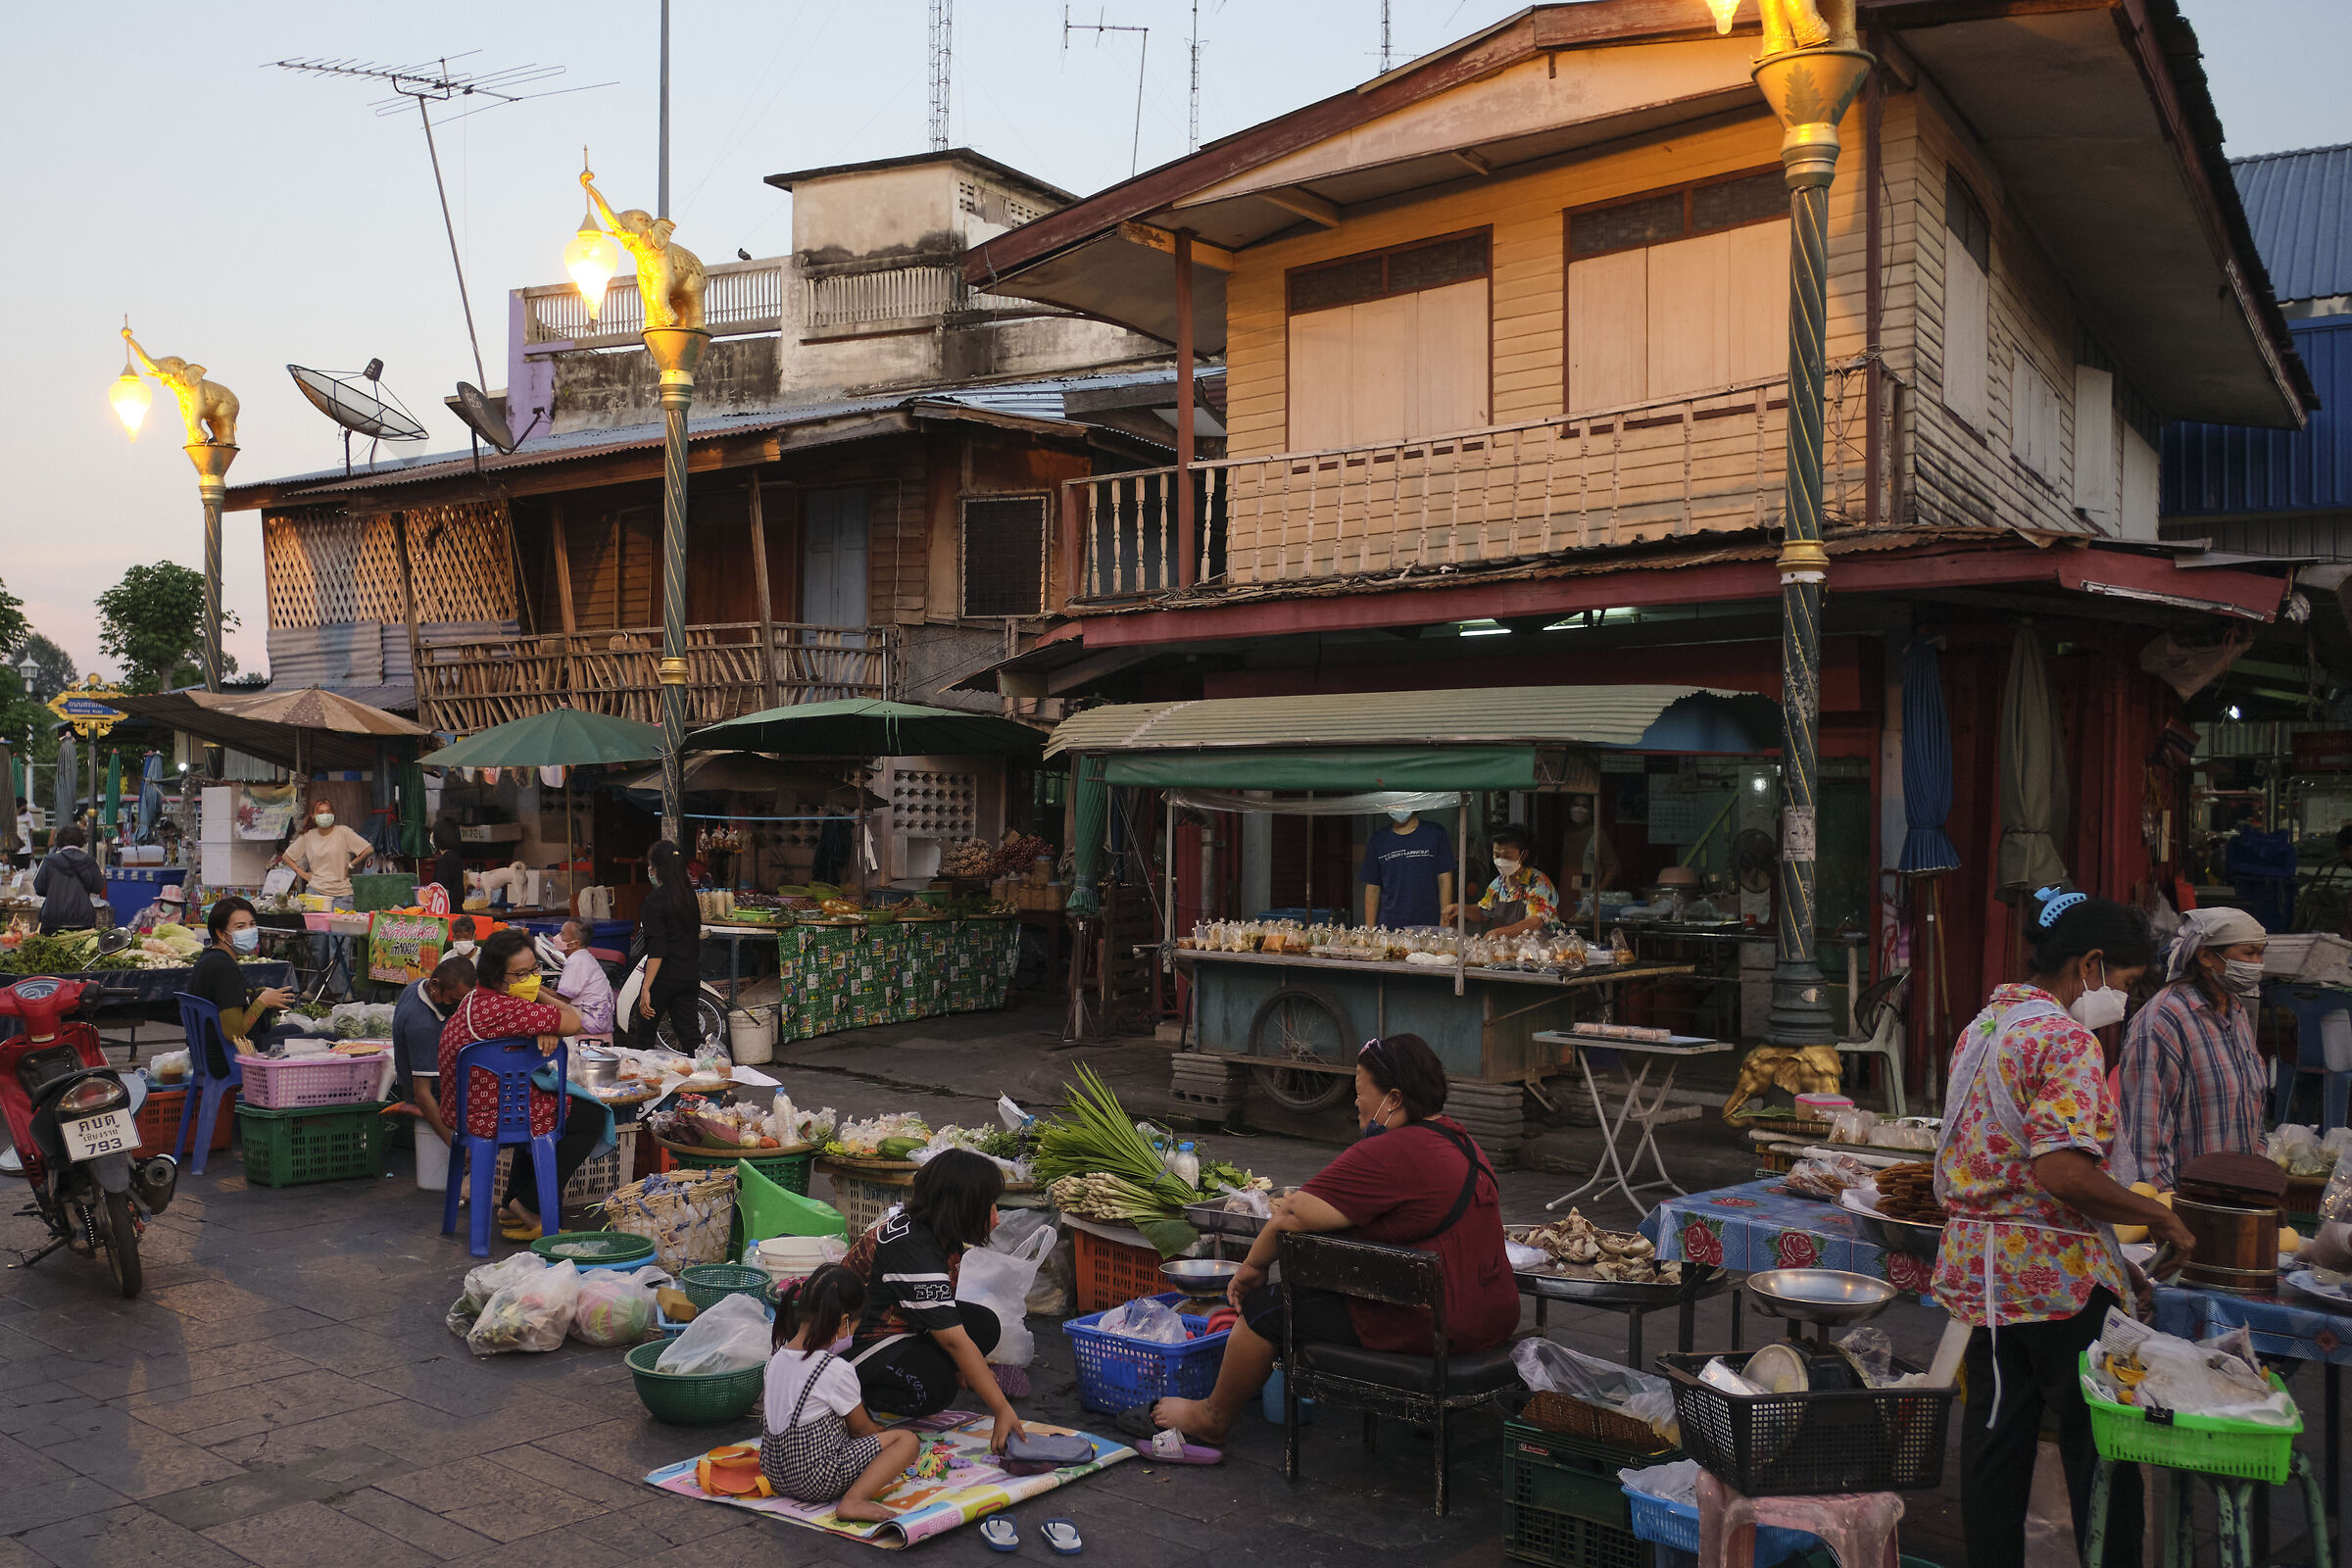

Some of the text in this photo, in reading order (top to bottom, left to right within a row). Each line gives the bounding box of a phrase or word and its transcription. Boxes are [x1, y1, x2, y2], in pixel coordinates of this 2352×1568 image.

[431, 892, 445, 915] 10
[83, 1128, 119, 1143] เชียงราย
[85, 1138, 122, 1155] 793
